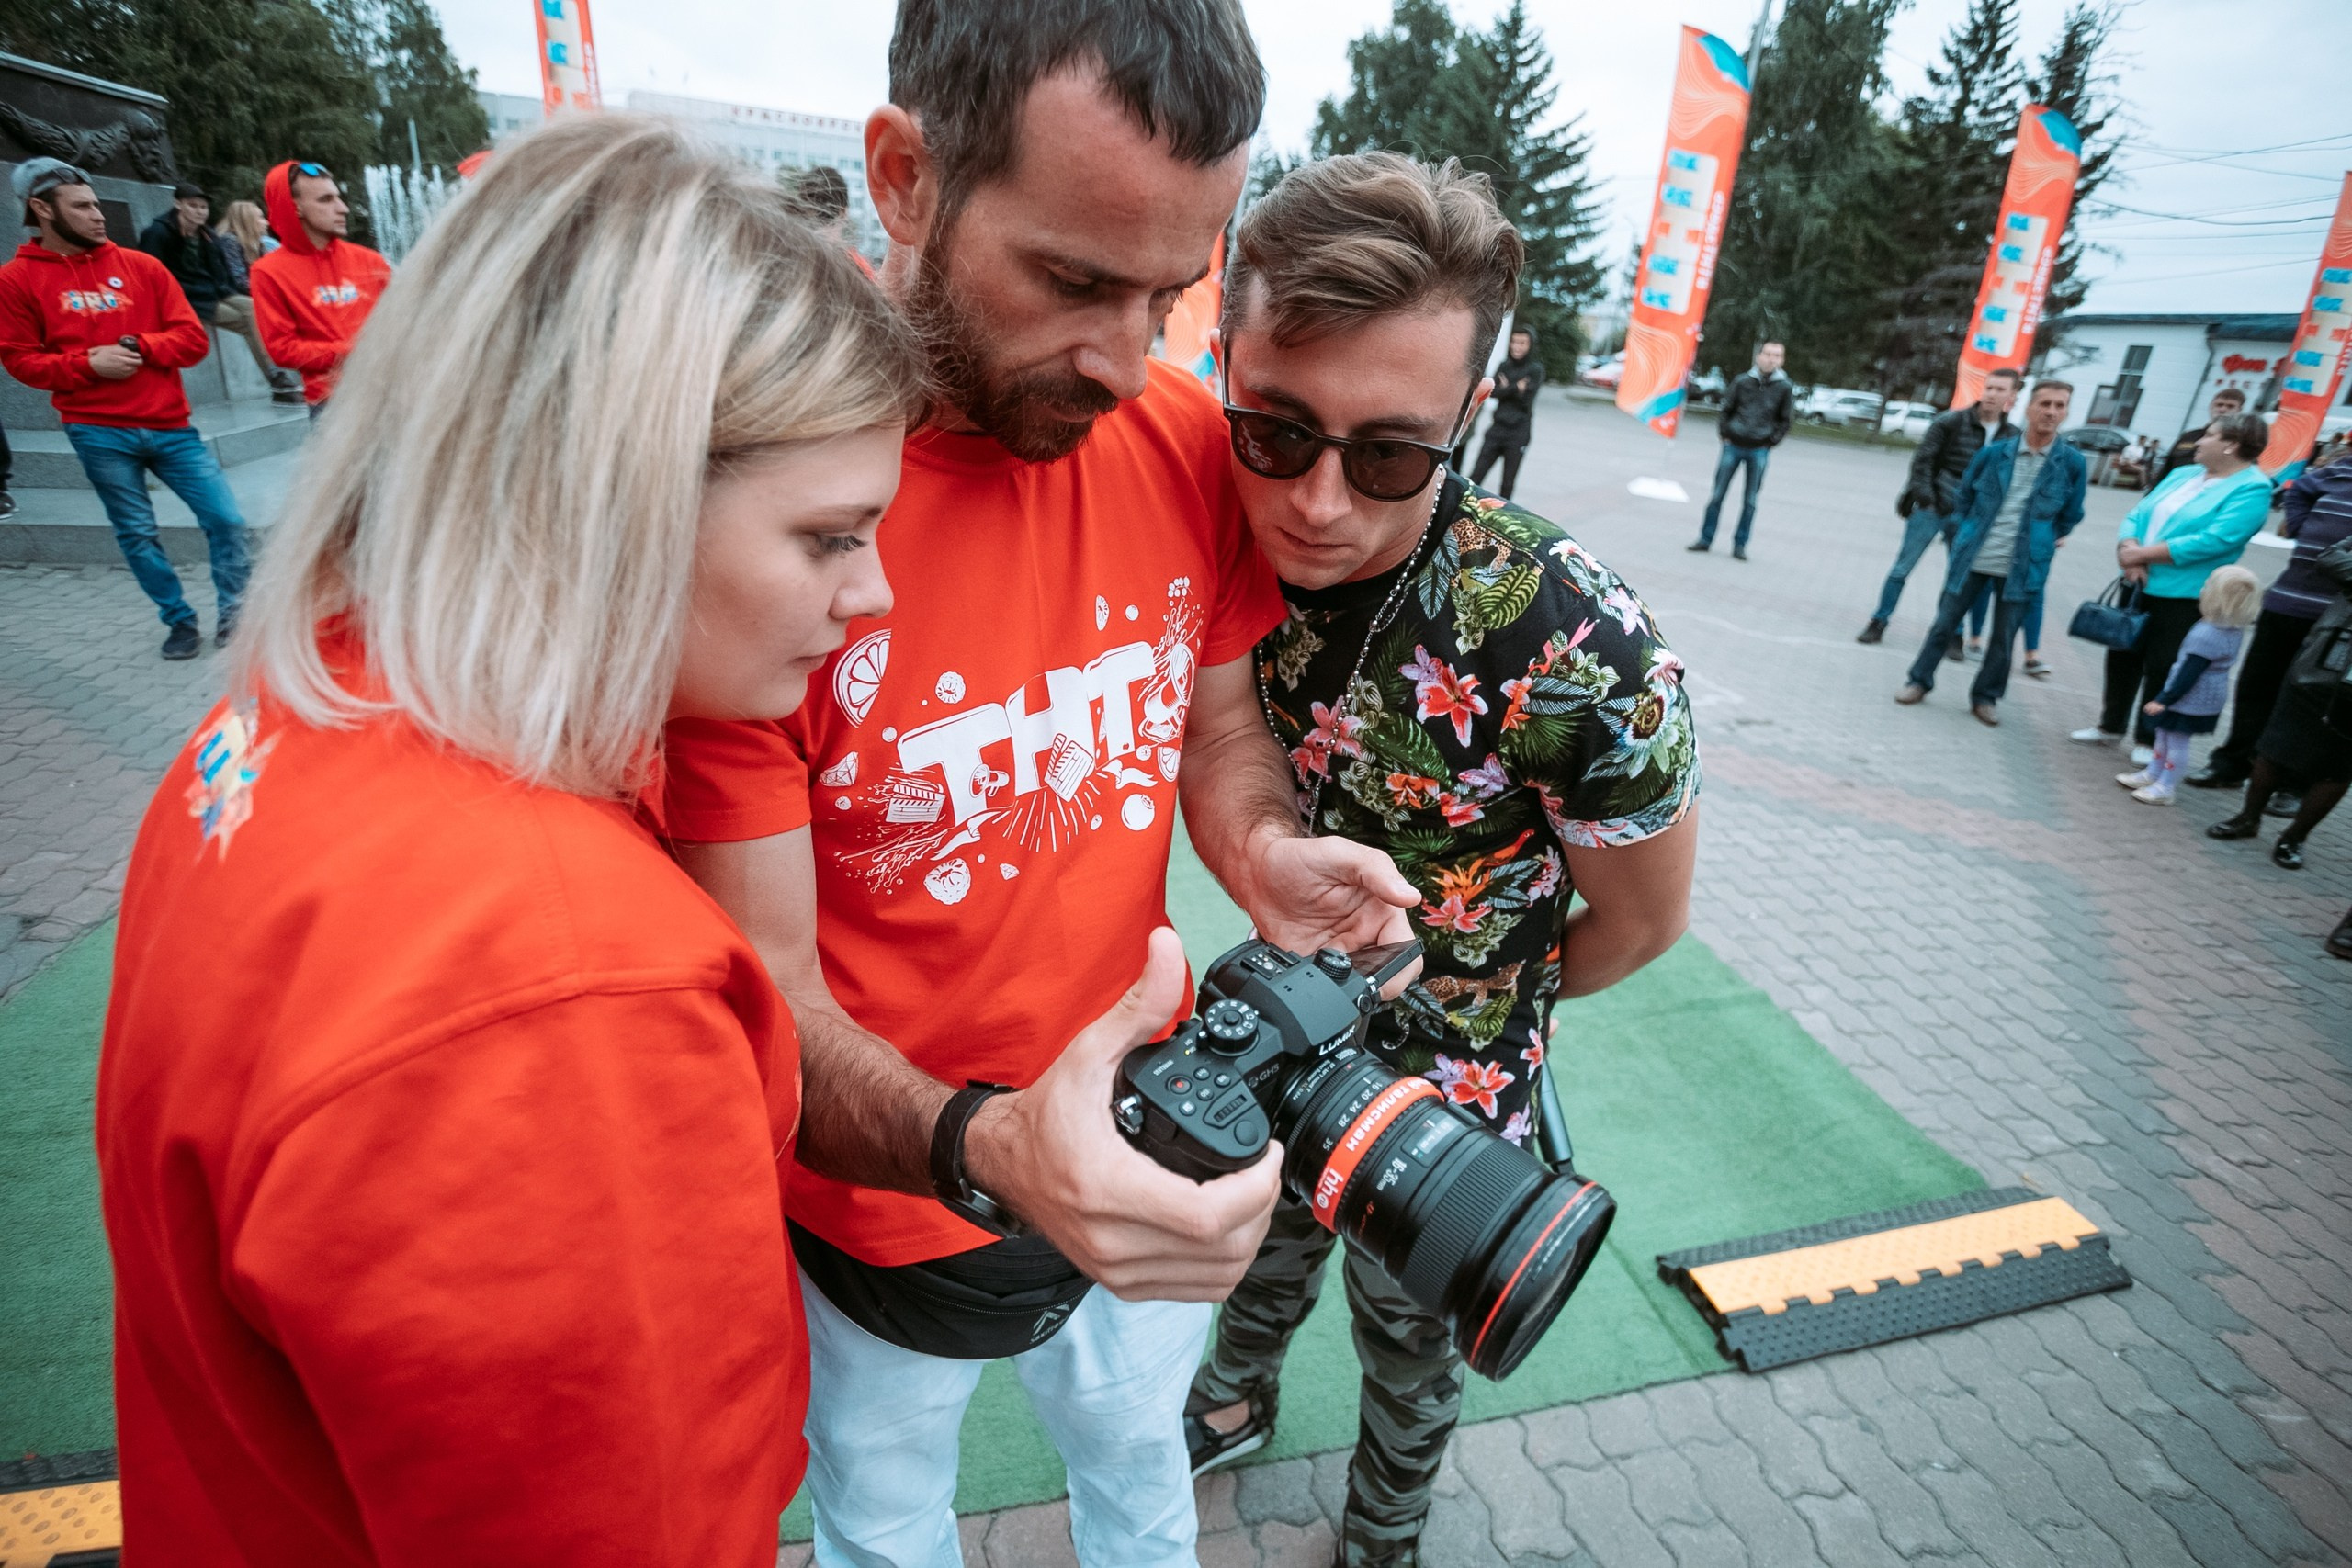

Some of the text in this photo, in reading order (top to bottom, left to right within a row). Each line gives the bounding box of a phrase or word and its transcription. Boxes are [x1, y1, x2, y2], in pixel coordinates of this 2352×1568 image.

[897, 640, 1157, 827] ТНТ
[1318, 1024, 1356, 1055] LUMIX
[1259, 1063, 1280, 1081] GH5
[1361, 1089, 1373, 1100] 20
[1349, 1100, 1362, 1113] 24
[1338, 1114, 1351, 1128] 28
[1345, 1086, 1411, 1152] талисман
[1322, 1137, 1333, 1151] 35
